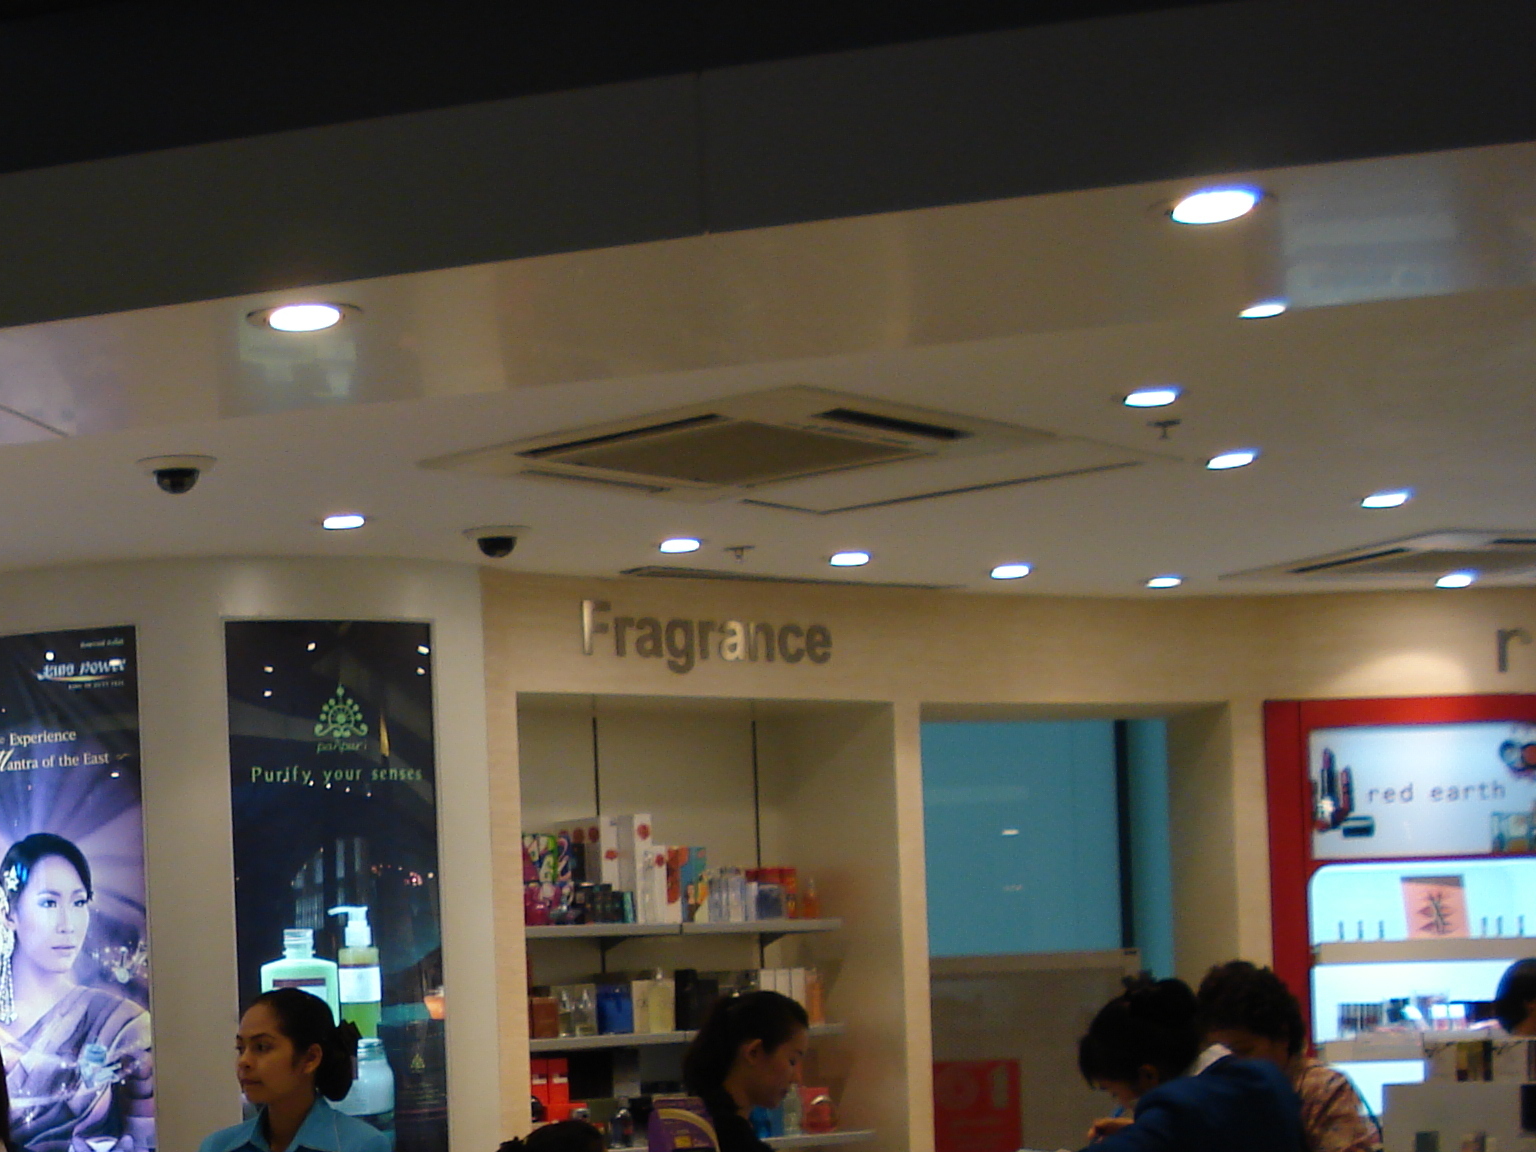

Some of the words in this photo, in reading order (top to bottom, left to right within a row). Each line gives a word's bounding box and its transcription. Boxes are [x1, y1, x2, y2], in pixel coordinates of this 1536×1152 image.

[581, 599, 833, 674] Fragrance
[9, 730, 77, 747] Experience
[42, 756, 55, 768] of
[58, 754, 80, 767] the
[83, 752, 110, 766] East
[251, 765, 312, 785] Purify
[323, 768, 362, 786] your
[371, 766, 423, 782] senses
[1367, 782, 1414, 804] red
[1431, 780, 1506, 802] earth
